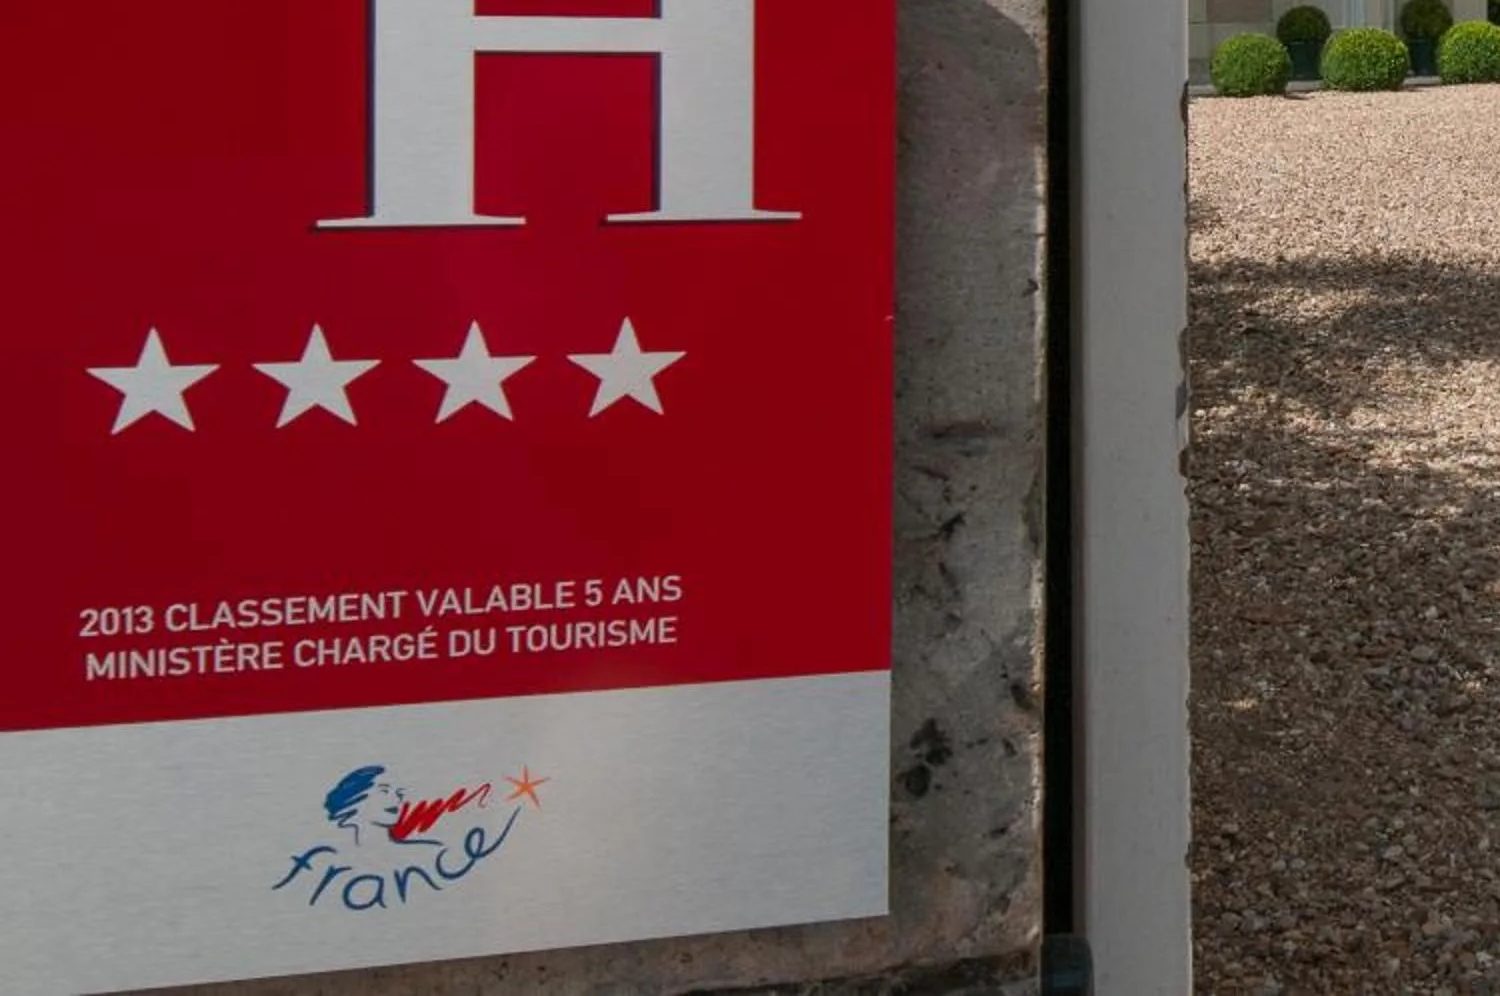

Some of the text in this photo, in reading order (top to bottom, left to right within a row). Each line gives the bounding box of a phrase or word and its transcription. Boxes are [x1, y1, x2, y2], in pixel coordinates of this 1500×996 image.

[79, 575, 682, 637] 2013 CLASSEMENT VALABLE 5 ANS
[86, 616, 678, 681] MINISTÈRE CHARGÉ DU TOURISME
[271, 805, 522, 911] france
